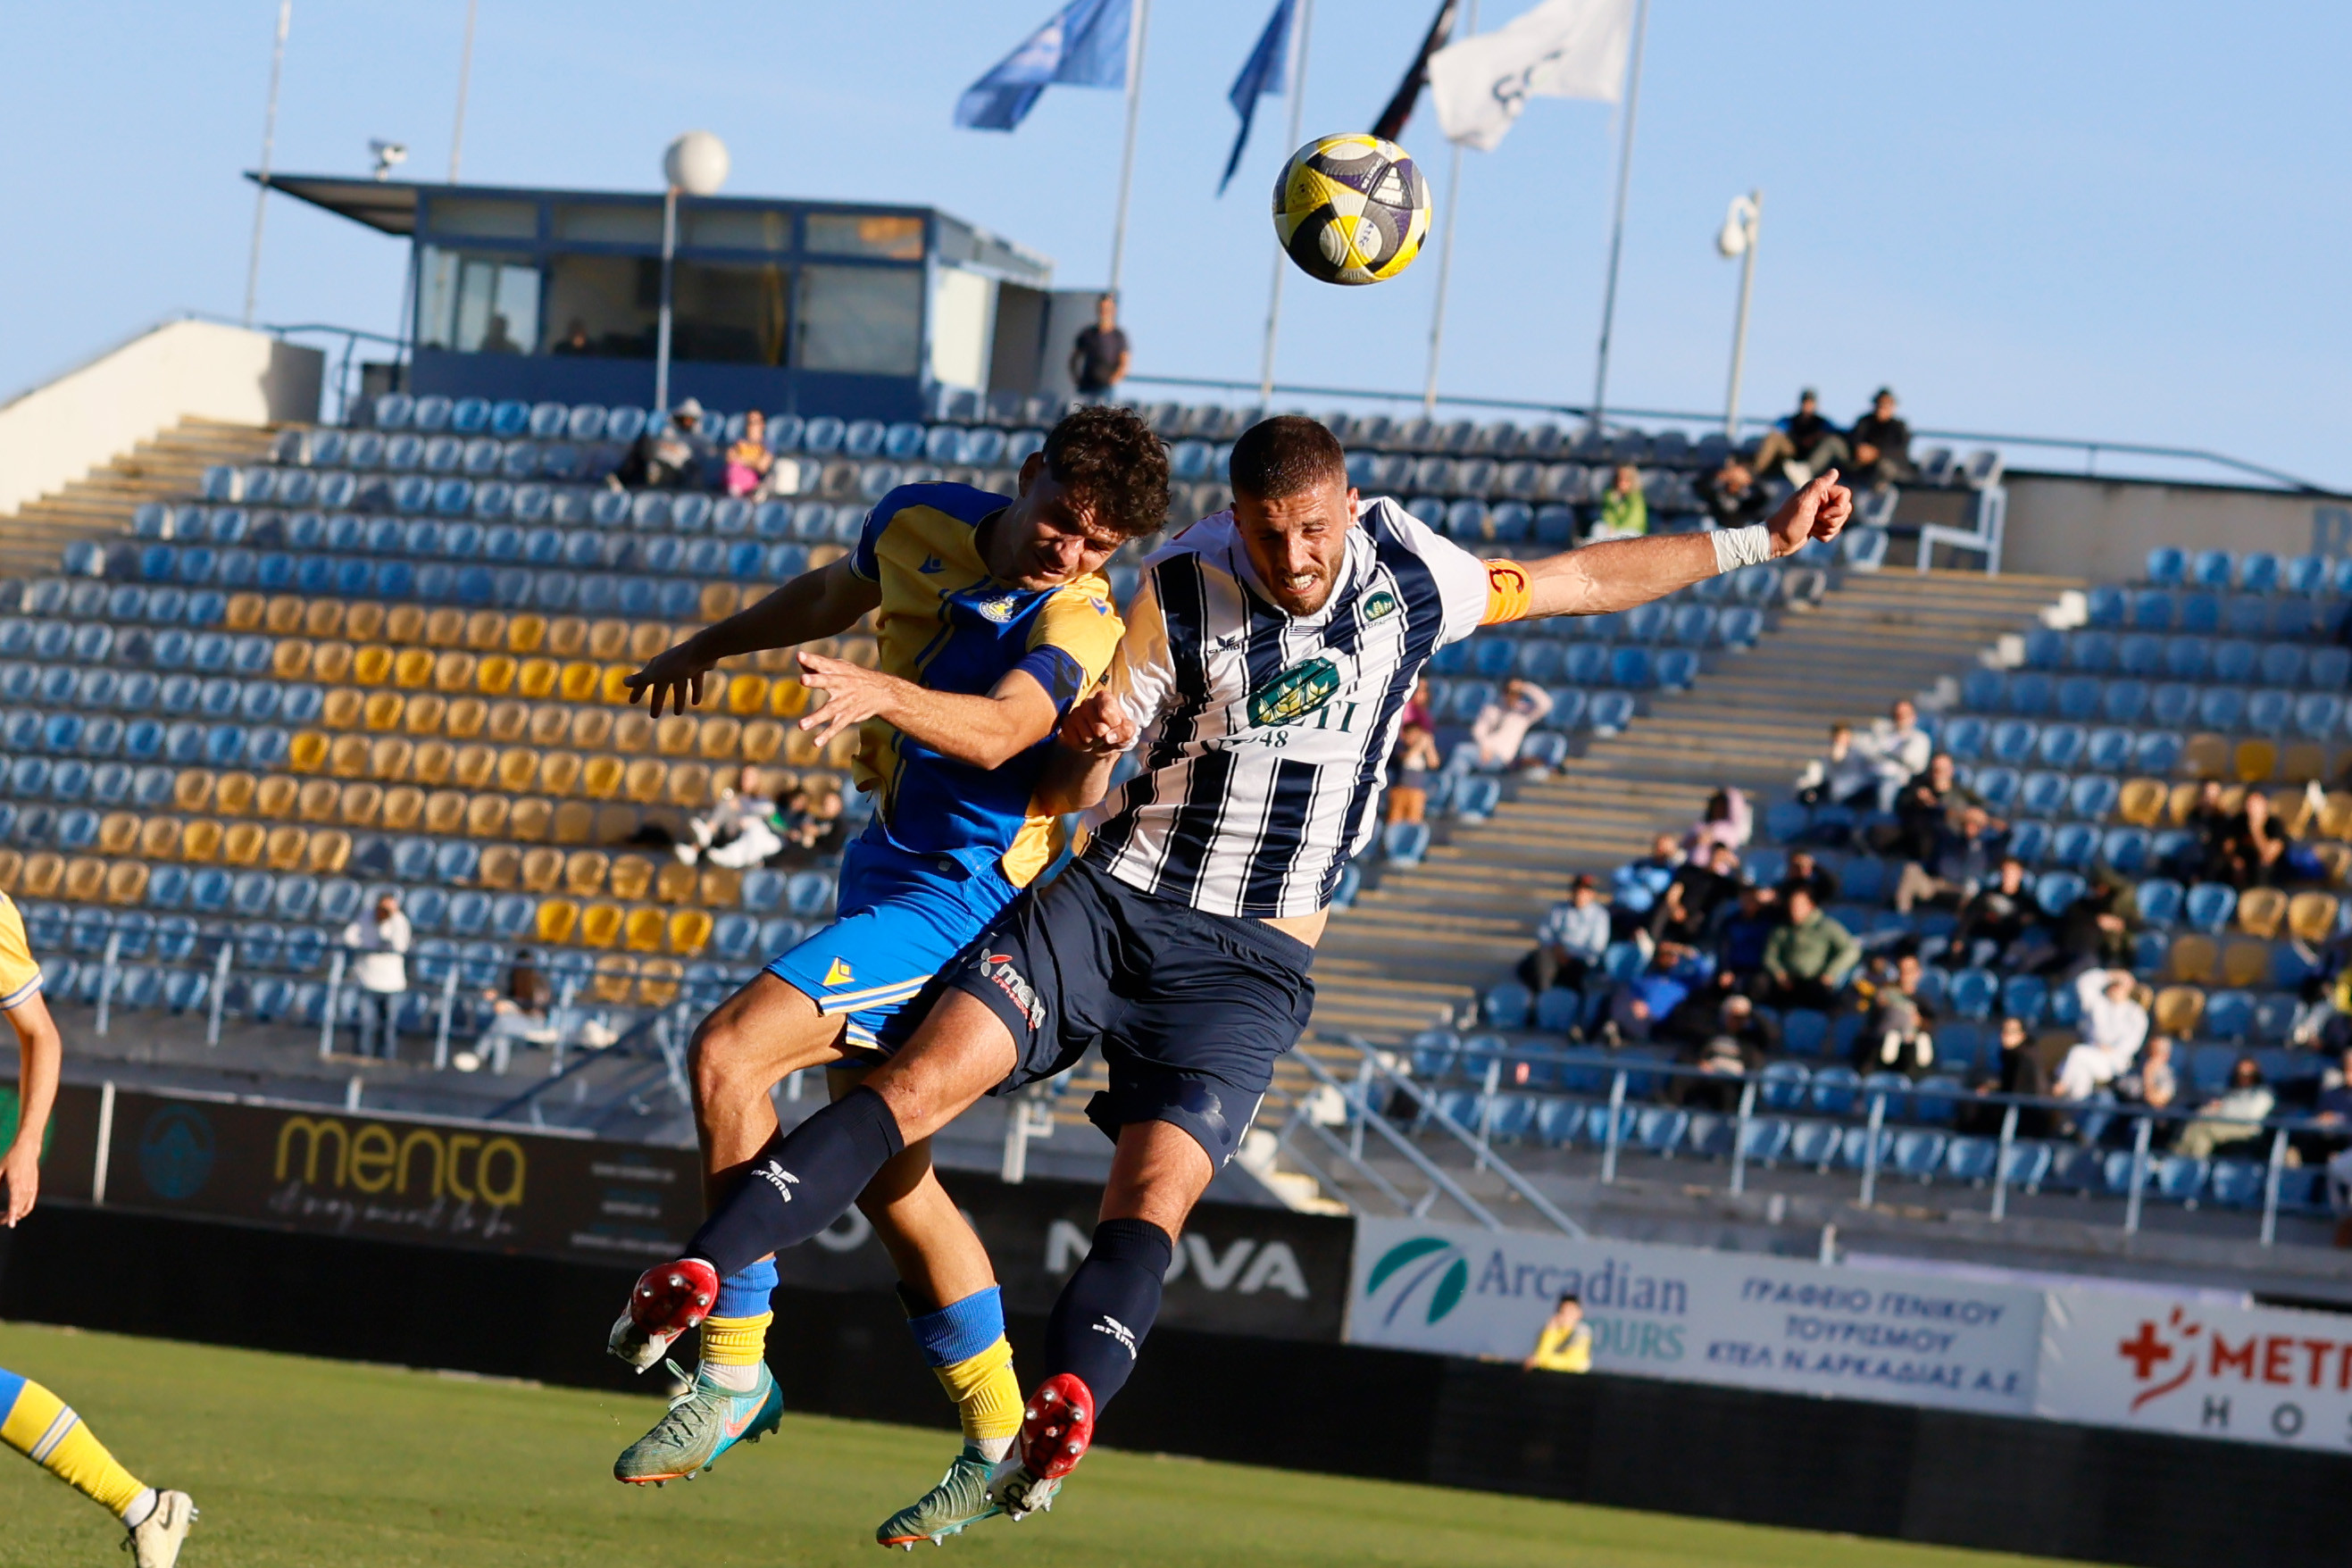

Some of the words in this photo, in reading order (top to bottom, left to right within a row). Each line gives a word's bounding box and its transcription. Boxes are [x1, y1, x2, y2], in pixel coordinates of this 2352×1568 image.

[1476, 1247, 1690, 1315] Arcadian
[1588, 1314, 1687, 1363] OURS
[2202, 1397, 2352, 1444] HO
